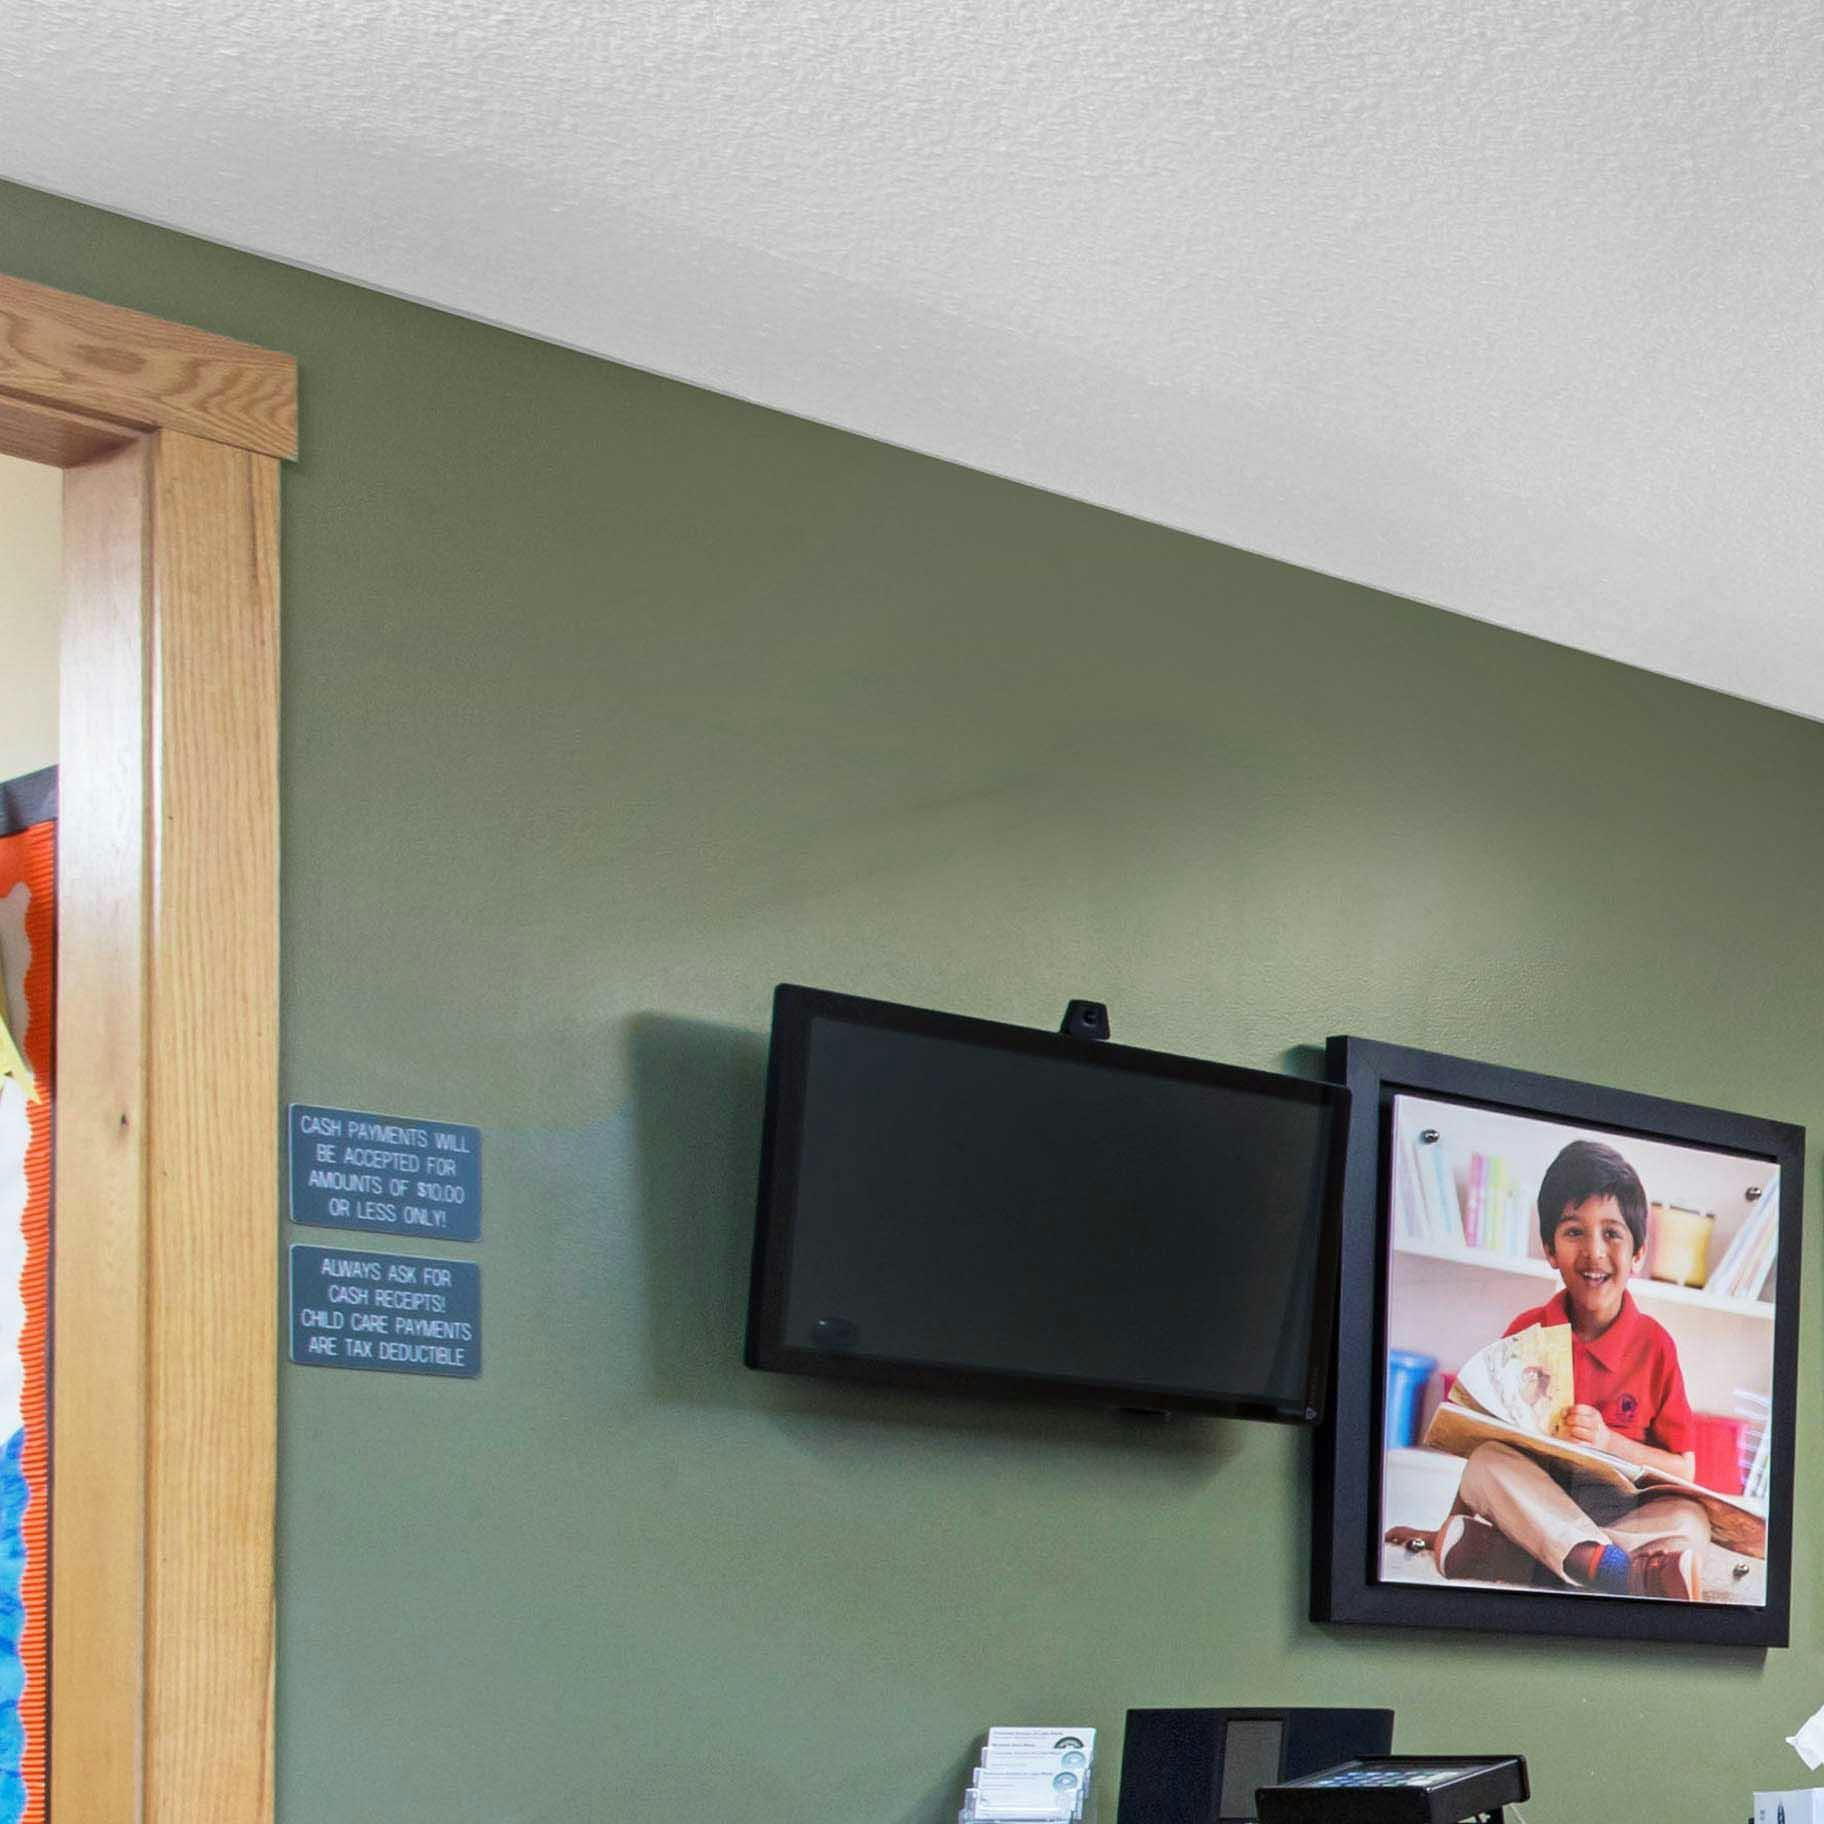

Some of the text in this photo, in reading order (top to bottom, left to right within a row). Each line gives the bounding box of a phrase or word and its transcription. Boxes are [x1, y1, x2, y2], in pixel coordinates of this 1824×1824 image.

[301, 1115, 470, 1153] CASH PAYMENTS WILL
[316, 1144, 456, 1176] BE ACCEPTED FOR
[308, 1170, 465, 1204] AMOUNTS OF $10.00
[329, 1198, 447, 1228] OR LESS ONLY!
[321, 1258, 452, 1287] ALWAYS ASK FOR
[328, 1285, 446, 1313] CASH RECEIPTS!
[301, 1309, 472, 1341] CHILD CARE PAYMENTS
[309, 1337, 465, 1366] ARE TAX DEDUCTIBLE
